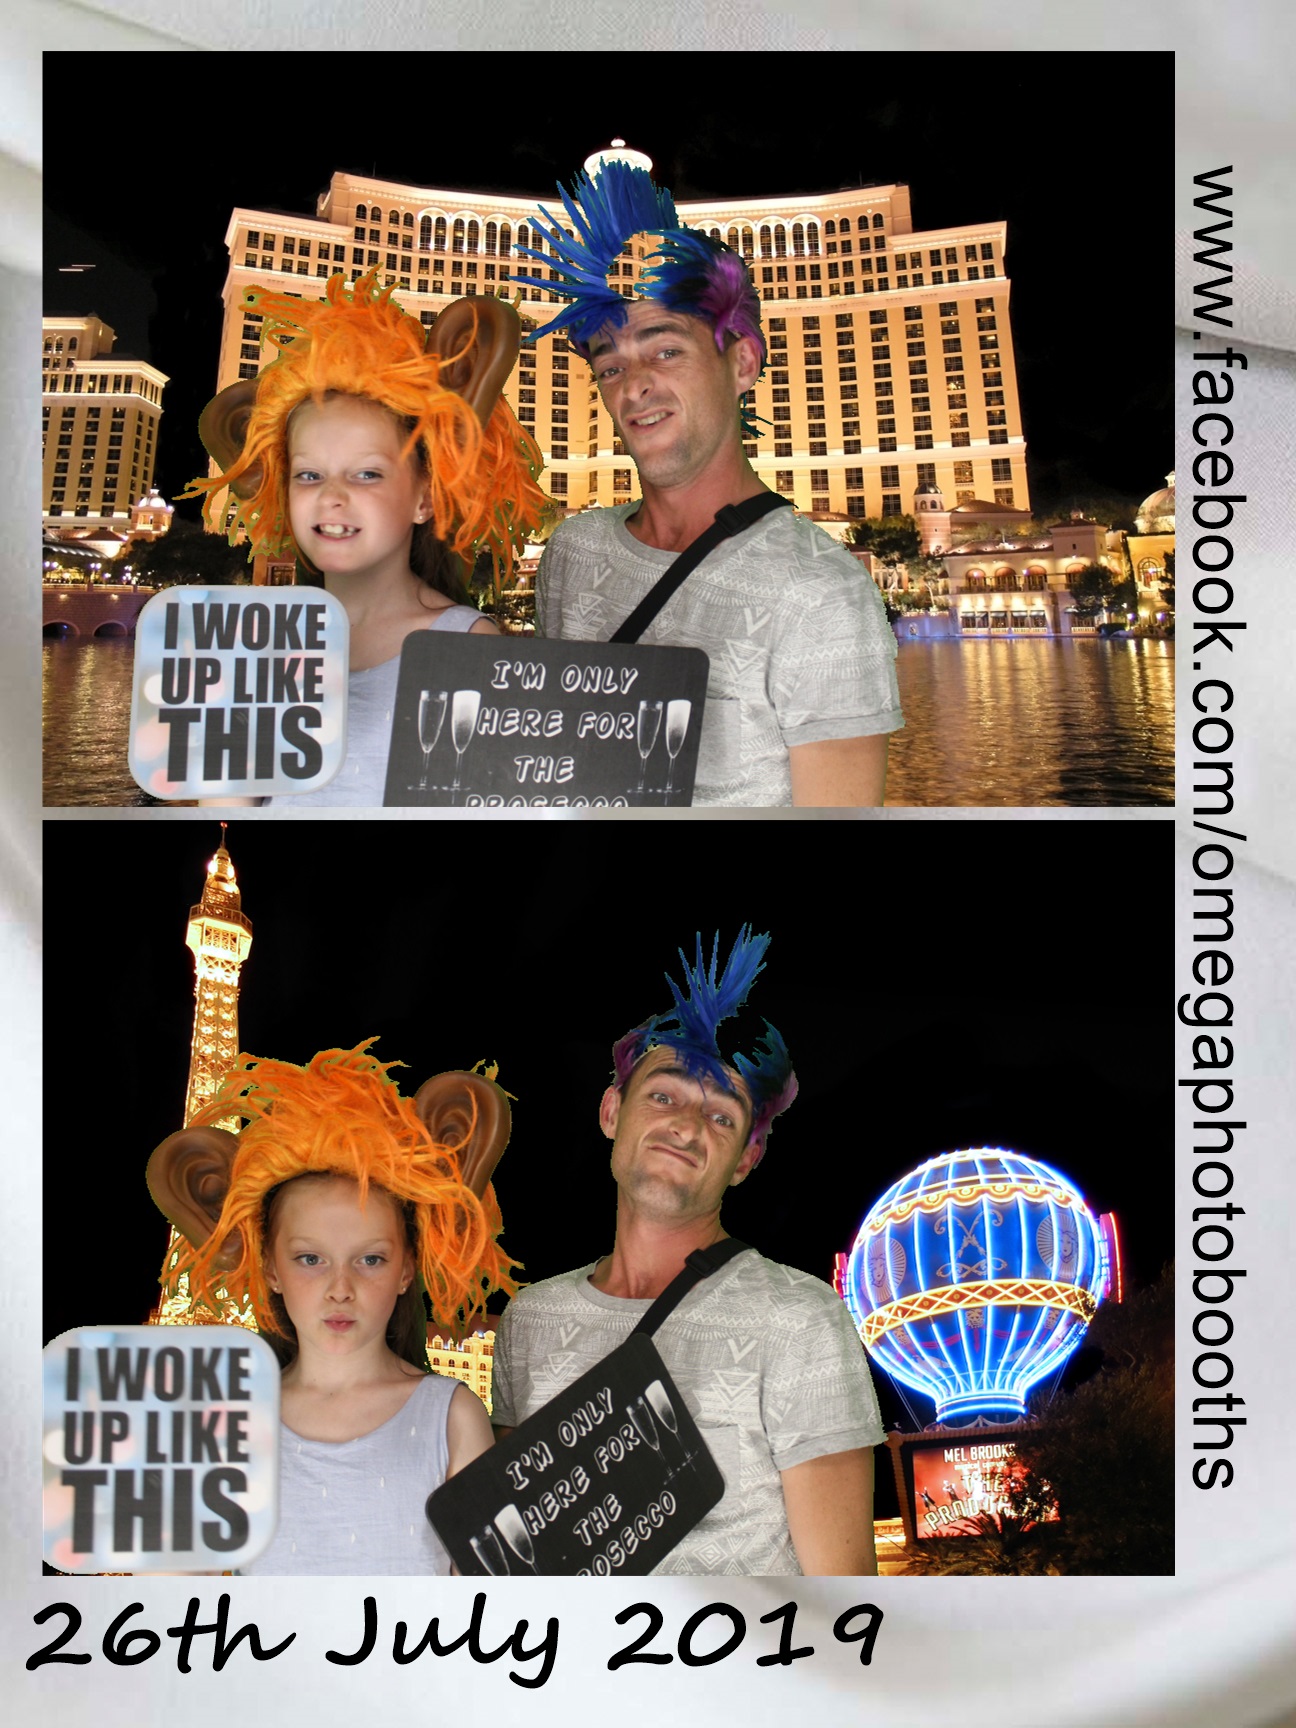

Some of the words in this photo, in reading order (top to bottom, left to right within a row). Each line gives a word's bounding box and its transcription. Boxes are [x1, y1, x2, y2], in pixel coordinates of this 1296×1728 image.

[164, 603, 179, 650] I
[192, 602, 326, 651] WOKE
[161, 657, 221, 705] UP
[233, 657, 324, 703] LIKE
[491, 660, 546, 691] I'M
[561, 664, 639, 695] ONLY
[158, 705, 323, 782] THIS
[477, 707, 563, 737] HERE
[577, 711, 635, 739] FOR
[514, 755, 575, 783] THE
[66, 1347, 80, 1401] I
[97, 1346, 251, 1402] WOKE
[63, 1410, 129, 1465] UP
[146, 1410, 250, 1464] LIKE
[506, 1441, 554, 1490] I'M
[558, 1387, 613, 1447] ONLY
[944, 1448, 968, 1463] MEL
[522, 1466, 590, 1535] HERE
[594, 1424, 640, 1474] FOR
[61, 1467, 250, 1553] THIS
[573, 1493, 622, 1546] THE
[576, 1491, 676, 1576] OSECCO
